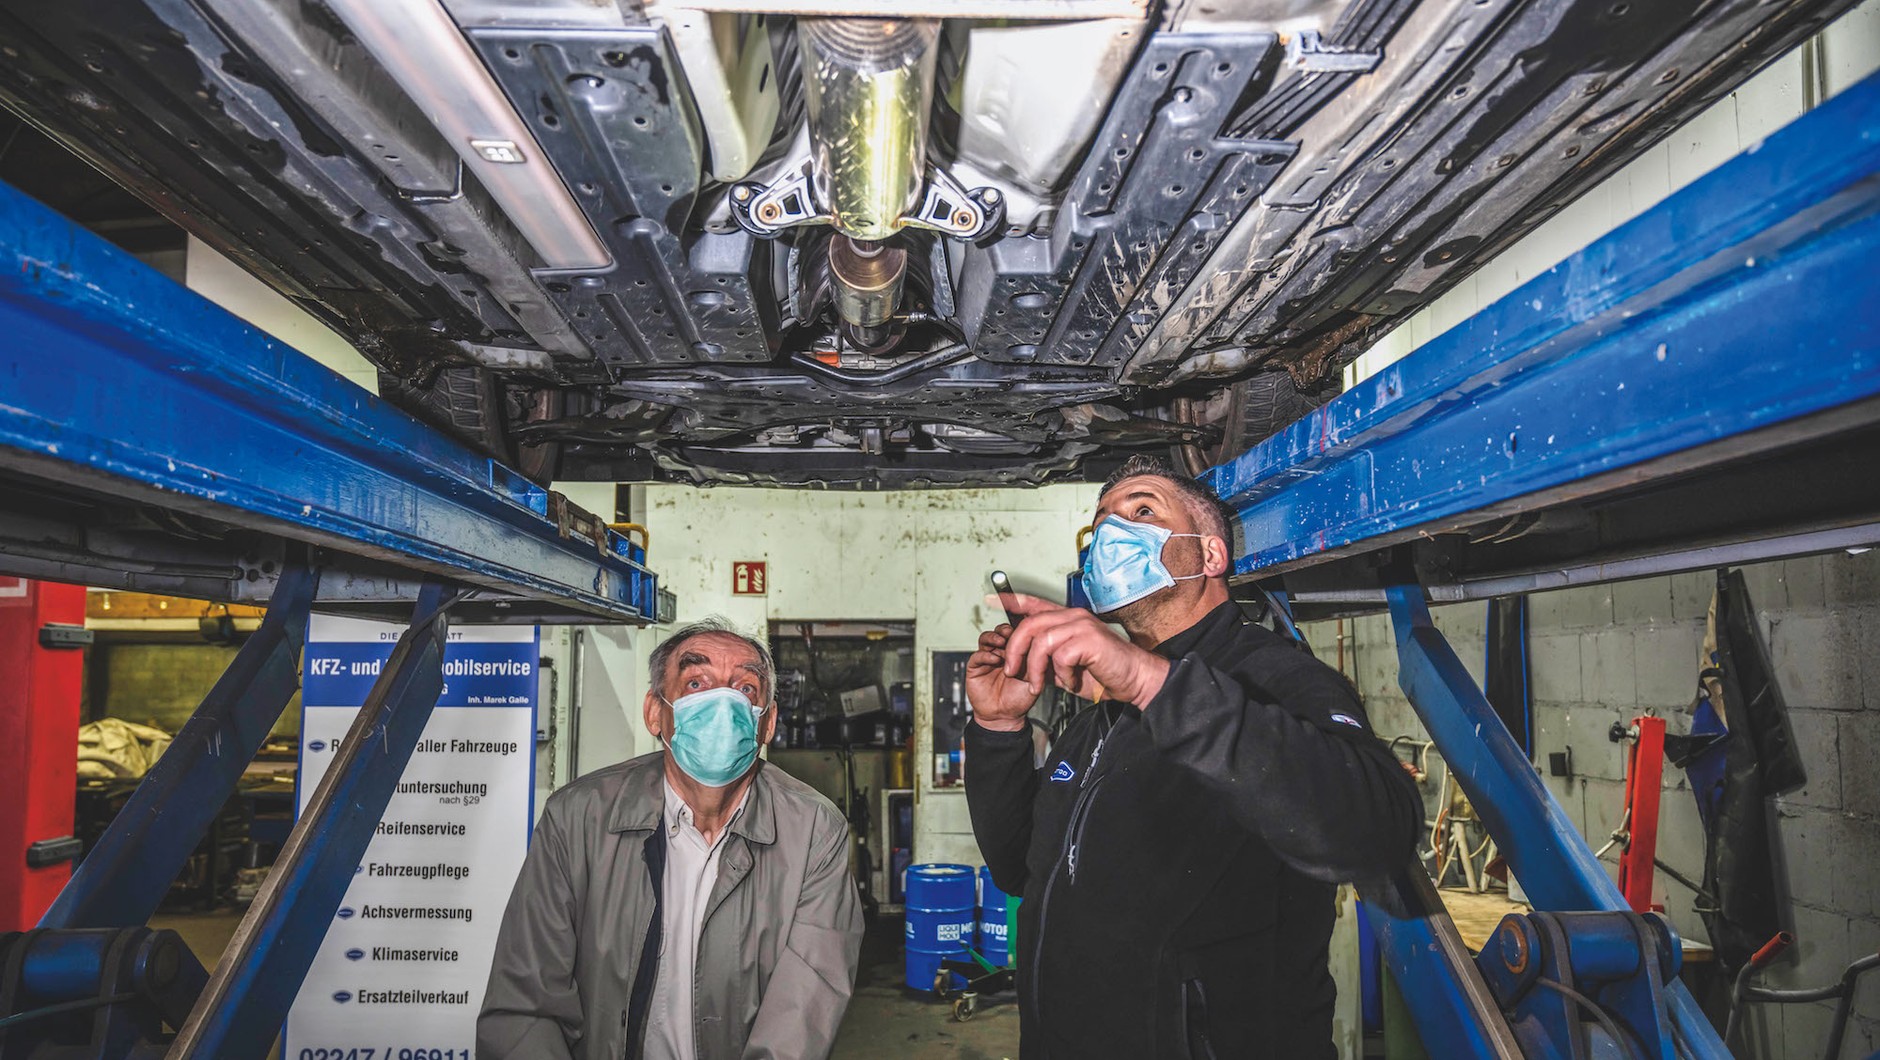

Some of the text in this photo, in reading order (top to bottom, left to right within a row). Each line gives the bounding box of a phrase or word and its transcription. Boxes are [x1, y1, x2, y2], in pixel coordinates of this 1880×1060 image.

[380, 632, 398, 640] DIE
[311, 658, 346, 676] KFZ-
[351, 658, 381, 676] und
[467, 696, 482, 704] Inh.
[483, 696, 507, 704] Marek
[417, 739, 517, 756] aller Fahrzeuge
[439, 796, 480, 806] nach §29
[377, 822, 466, 836] Reifenservice
[368, 863, 470, 881] Fahrzeugpflege
[361, 904, 472, 922] Achsvermessung
[372, 946, 459, 962] Klimaservice
[358, 989, 469, 1004] Ersatzteilverkauf
